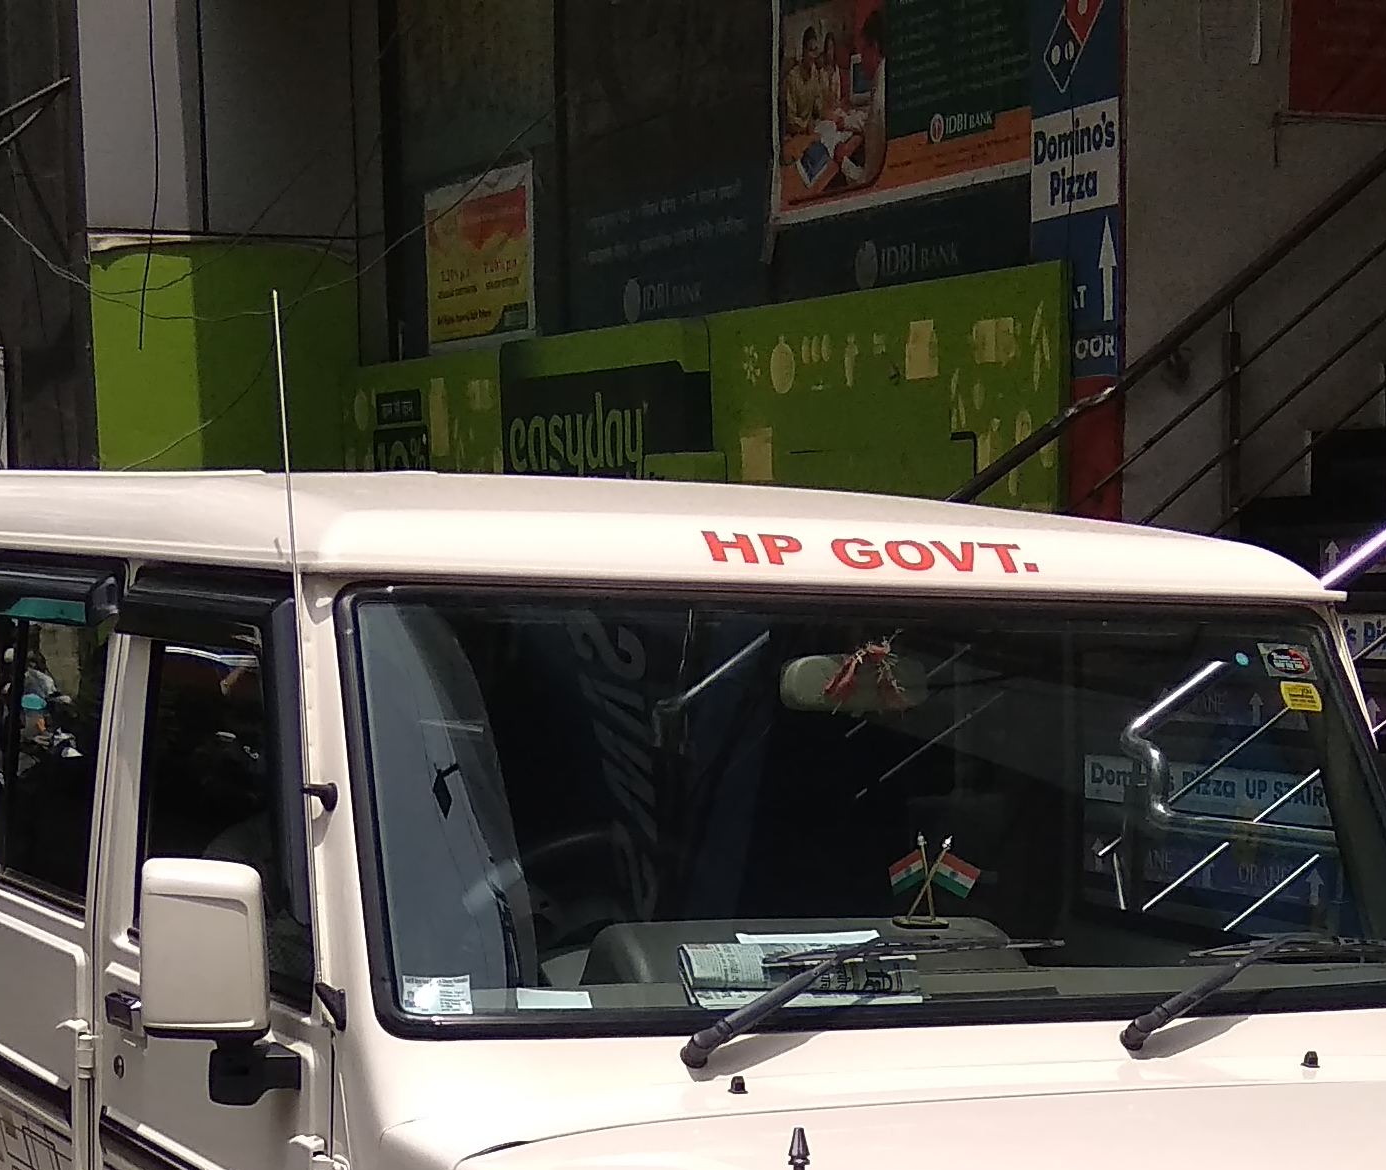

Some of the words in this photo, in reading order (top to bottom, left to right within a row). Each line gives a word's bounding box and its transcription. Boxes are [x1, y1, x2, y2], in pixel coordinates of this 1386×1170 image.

[945, 112, 968, 135] IDBI
[968, 110, 993, 130] BANK
[1033, 112, 1116, 166] Domino's
[1050, 170, 1098, 206] Pizza
[880, 240, 918, 278] IDBI
[919, 241, 960, 271] BANK
[640, 282, 670, 315] IDBI
[671, 279, 703, 308] BANK
[509, 391, 643, 479] easyday
[701, 531, 802, 566] HP
[832, 538, 1040, 573] GOVT.
[1245, 778, 1268, 800] UP
[1273, 780, 1325, 808] STAIR
